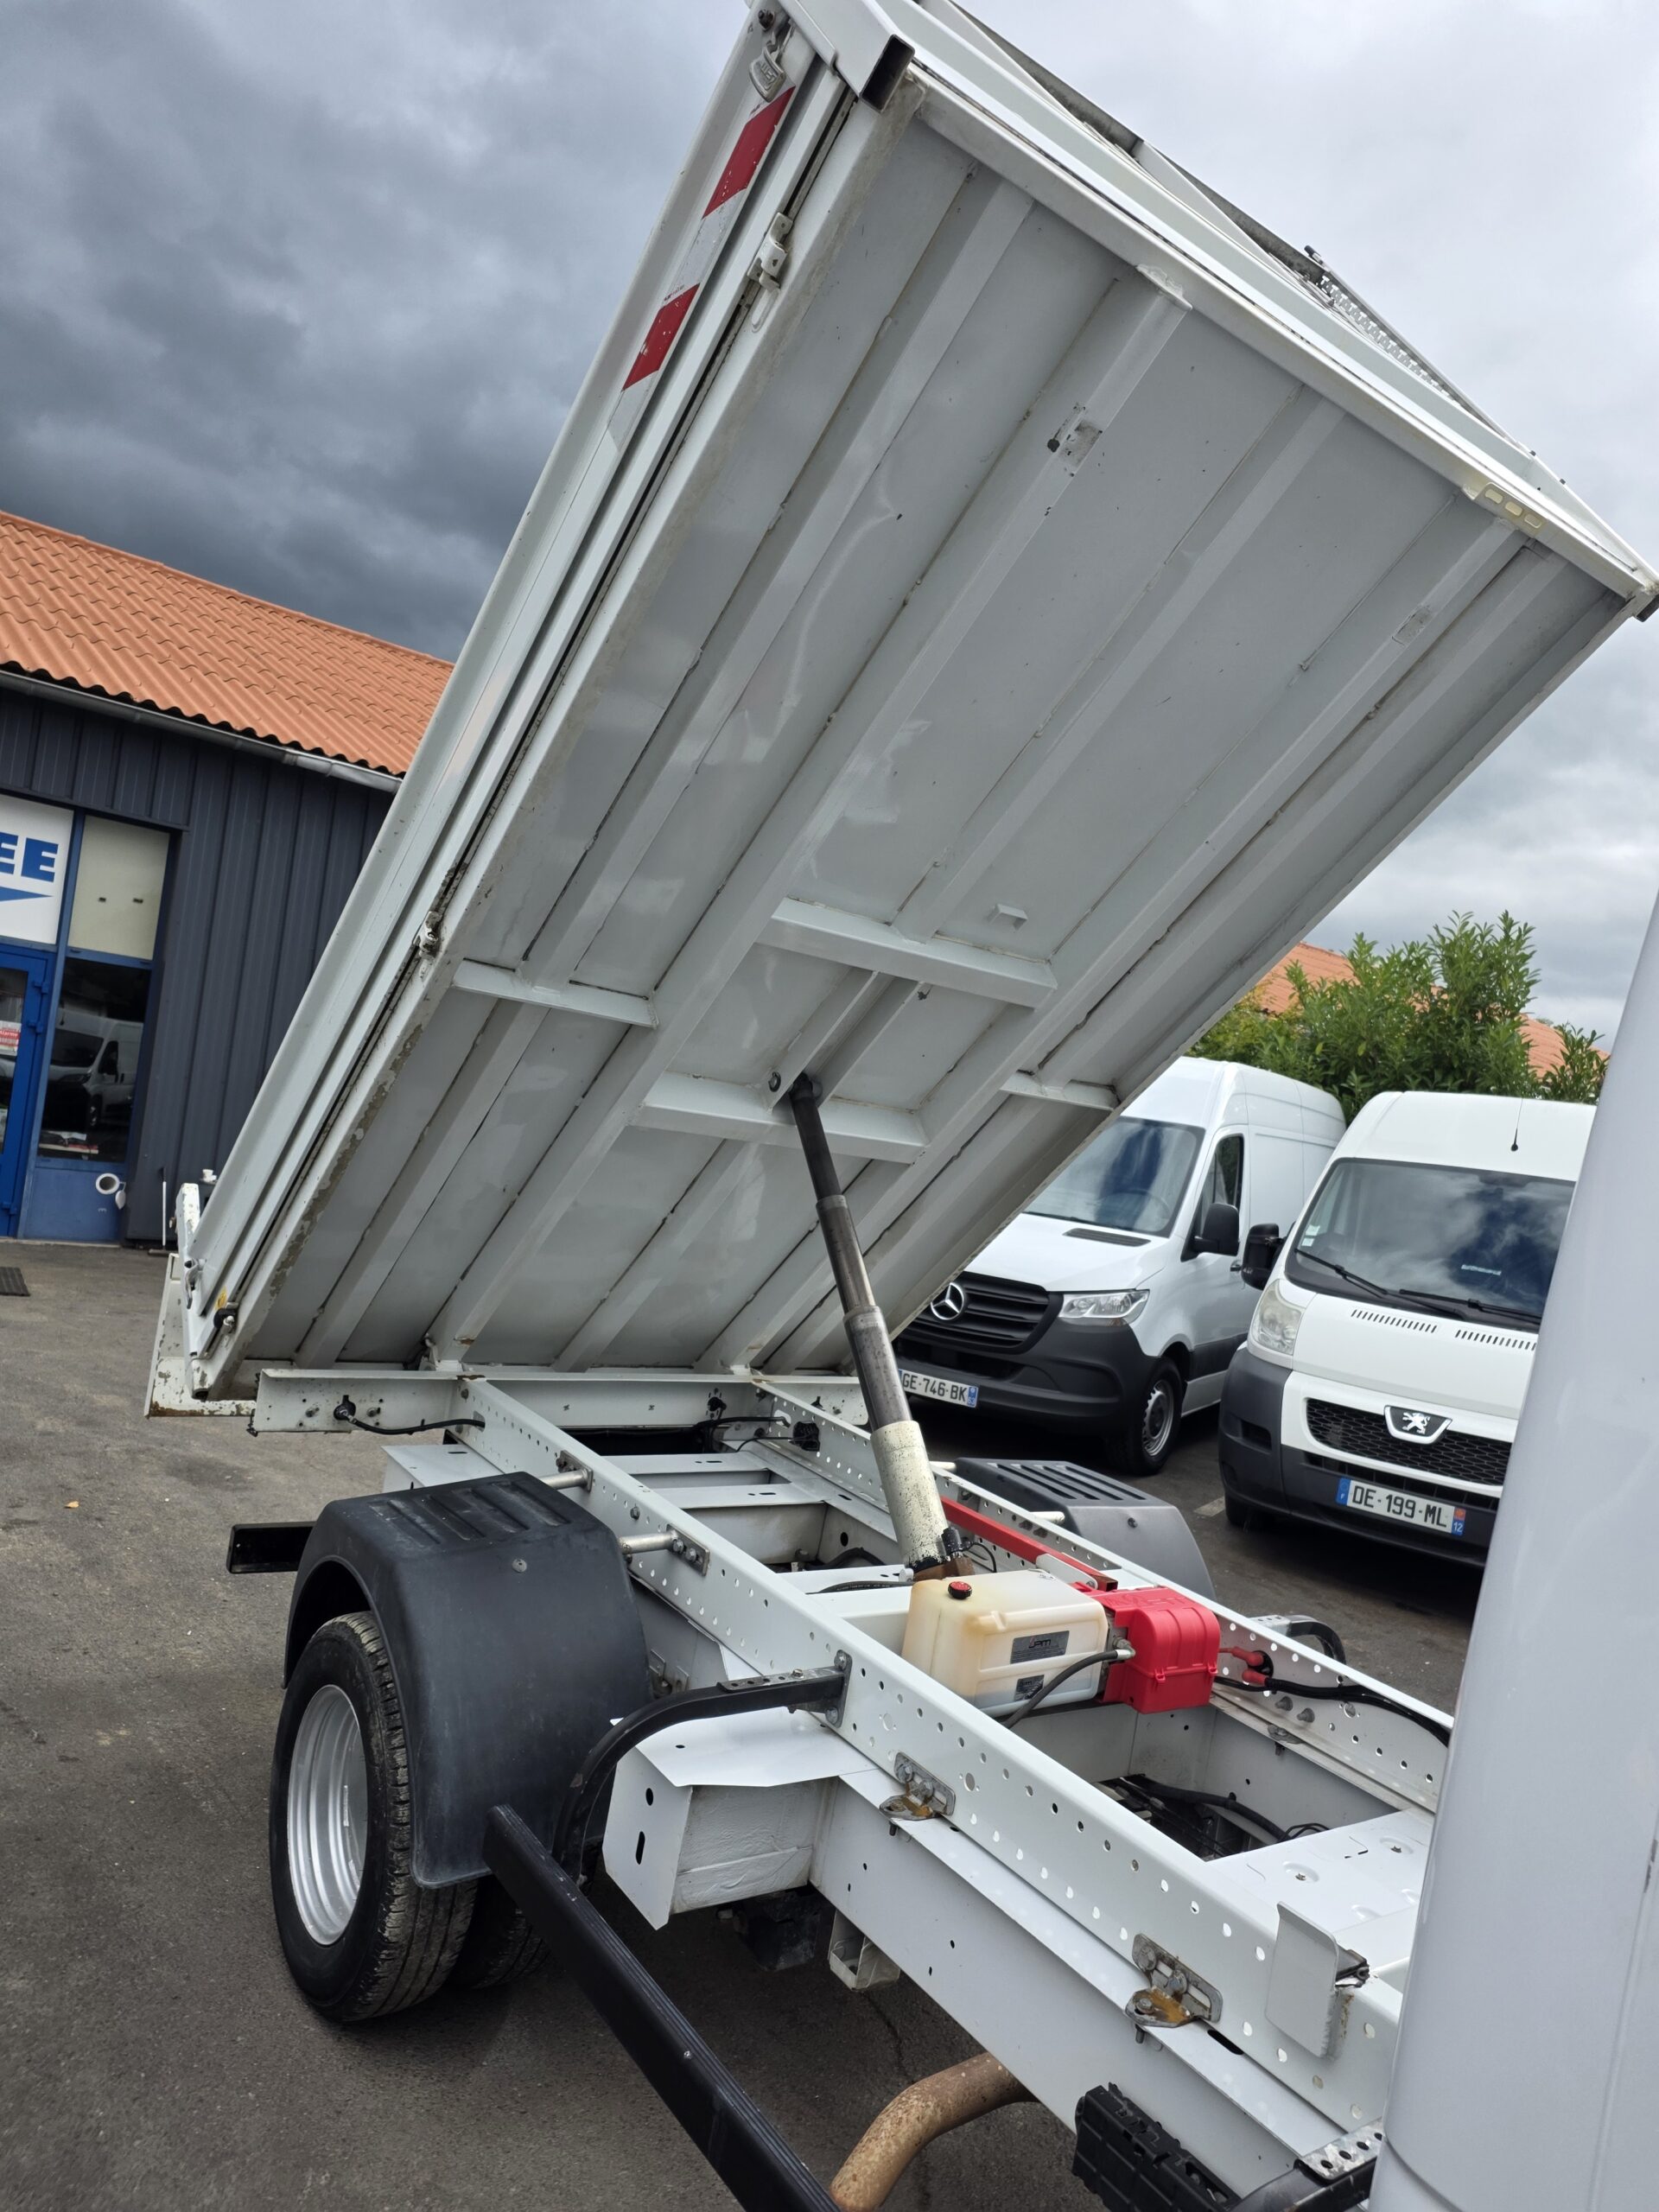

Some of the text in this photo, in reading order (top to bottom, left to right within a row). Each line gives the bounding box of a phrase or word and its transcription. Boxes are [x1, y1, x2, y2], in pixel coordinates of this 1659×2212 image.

[902, 1373, 968, 1402] GE-746-BK
[1351, 1485, 1447, 1528] DE-199-ML
[1453, 1522, 1464, 1533] 12
